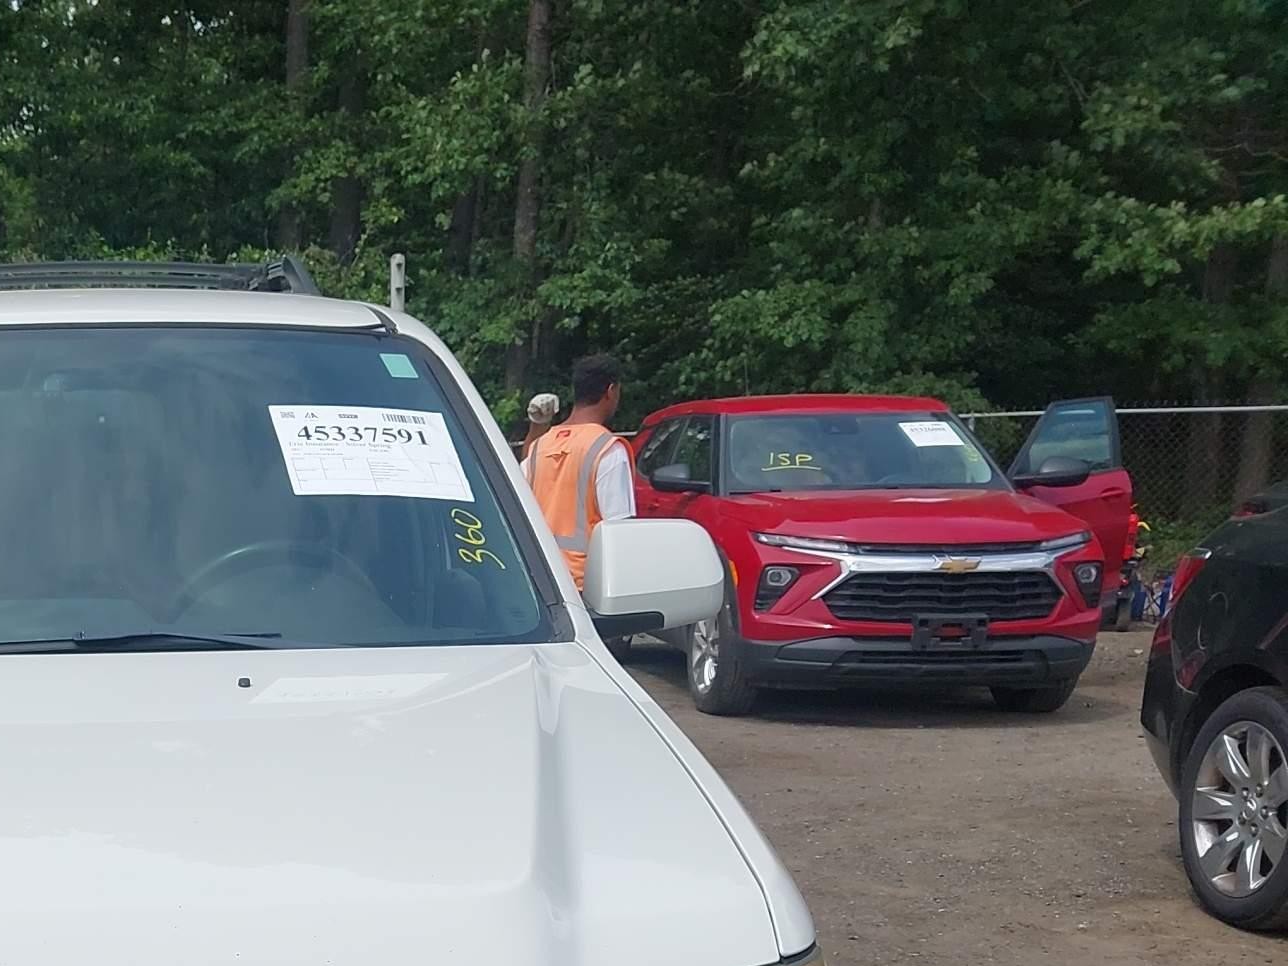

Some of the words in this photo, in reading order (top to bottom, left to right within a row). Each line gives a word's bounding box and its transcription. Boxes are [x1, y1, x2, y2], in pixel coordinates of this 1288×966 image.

[297, 425, 431, 446] 45337591
[769, 452, 813, 467] ISP
[450, 507, 506, 570] 360
